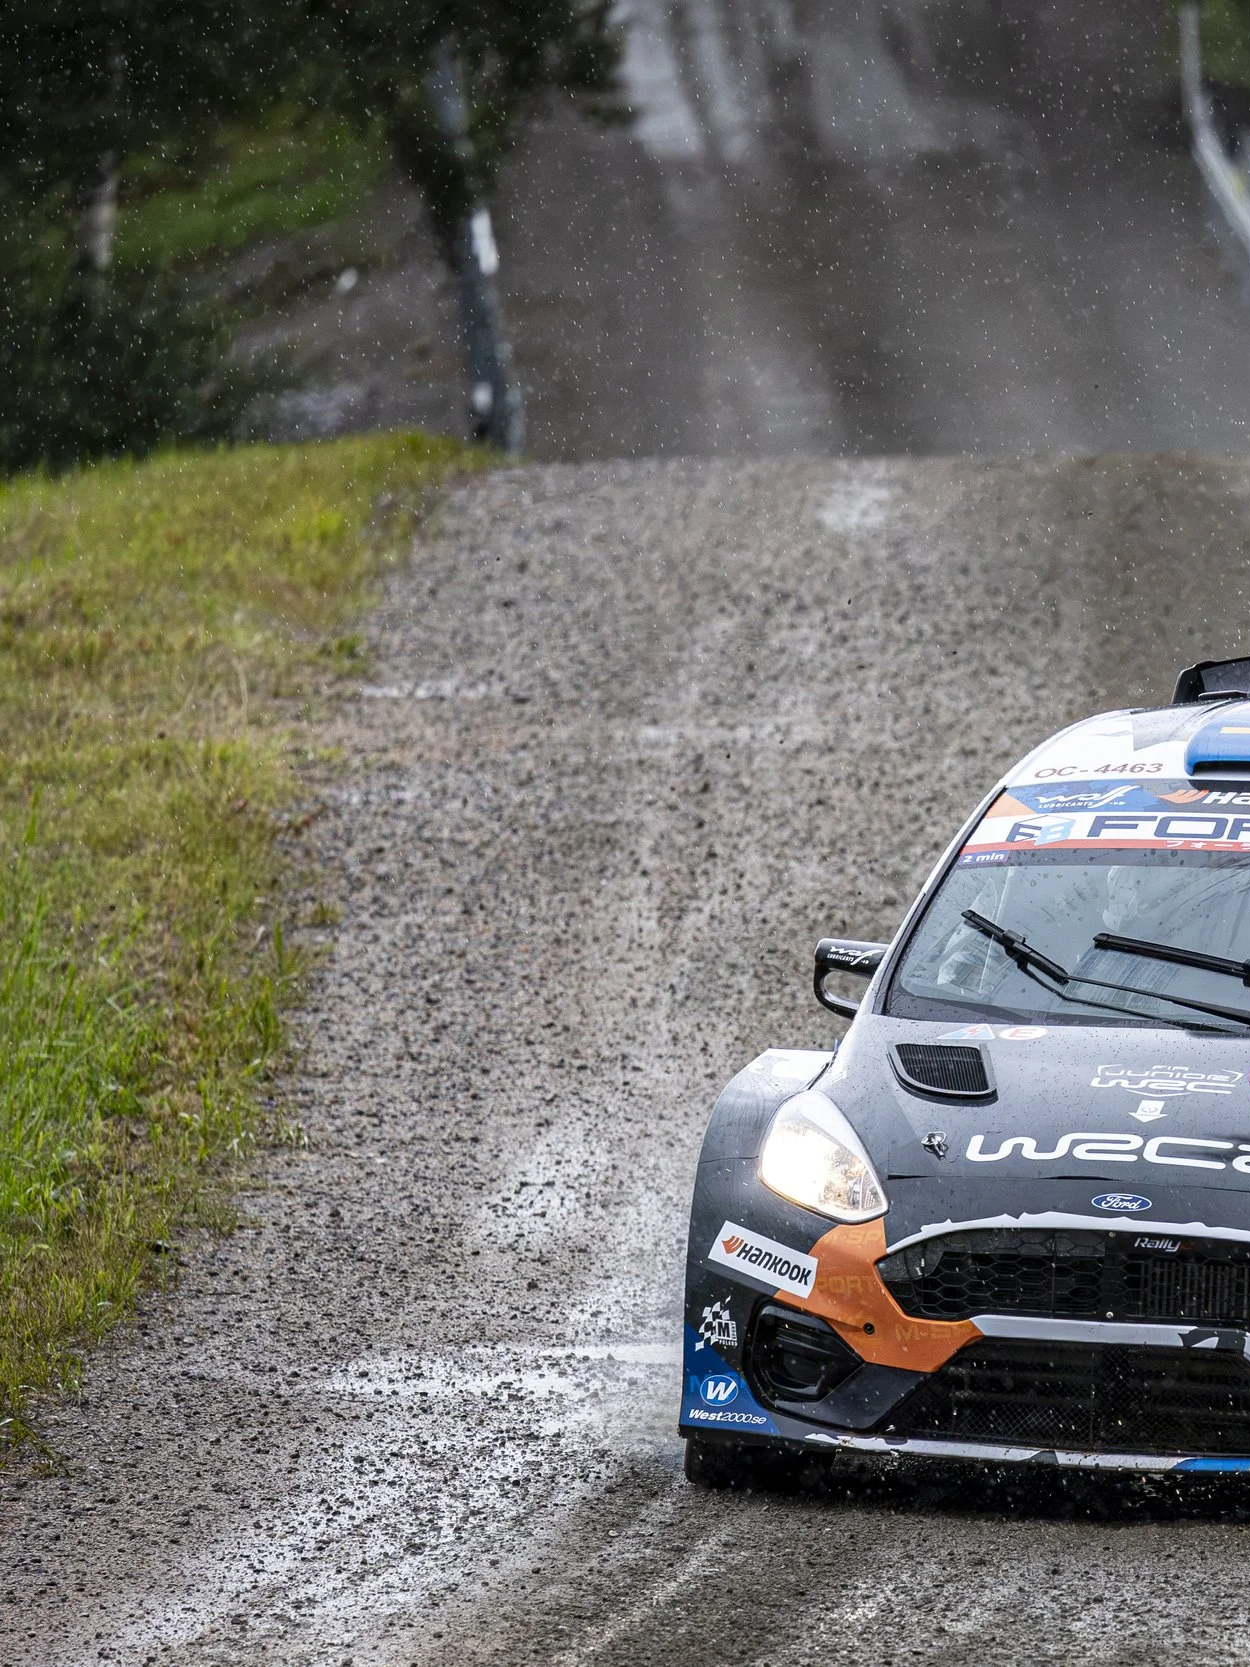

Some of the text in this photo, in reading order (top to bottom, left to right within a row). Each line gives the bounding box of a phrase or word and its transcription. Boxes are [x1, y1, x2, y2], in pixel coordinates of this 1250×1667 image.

[962, 852, 1005, 863] 2 min
[1090, 1077, 1236, 1095] WRC
[1101, 1195, 1142, 1209] Ford
[719, 1339, 738, 1347] POLAND
[706, 1381, 737, 1401] W
[689, 1409, 767, 1425] West2000.se
